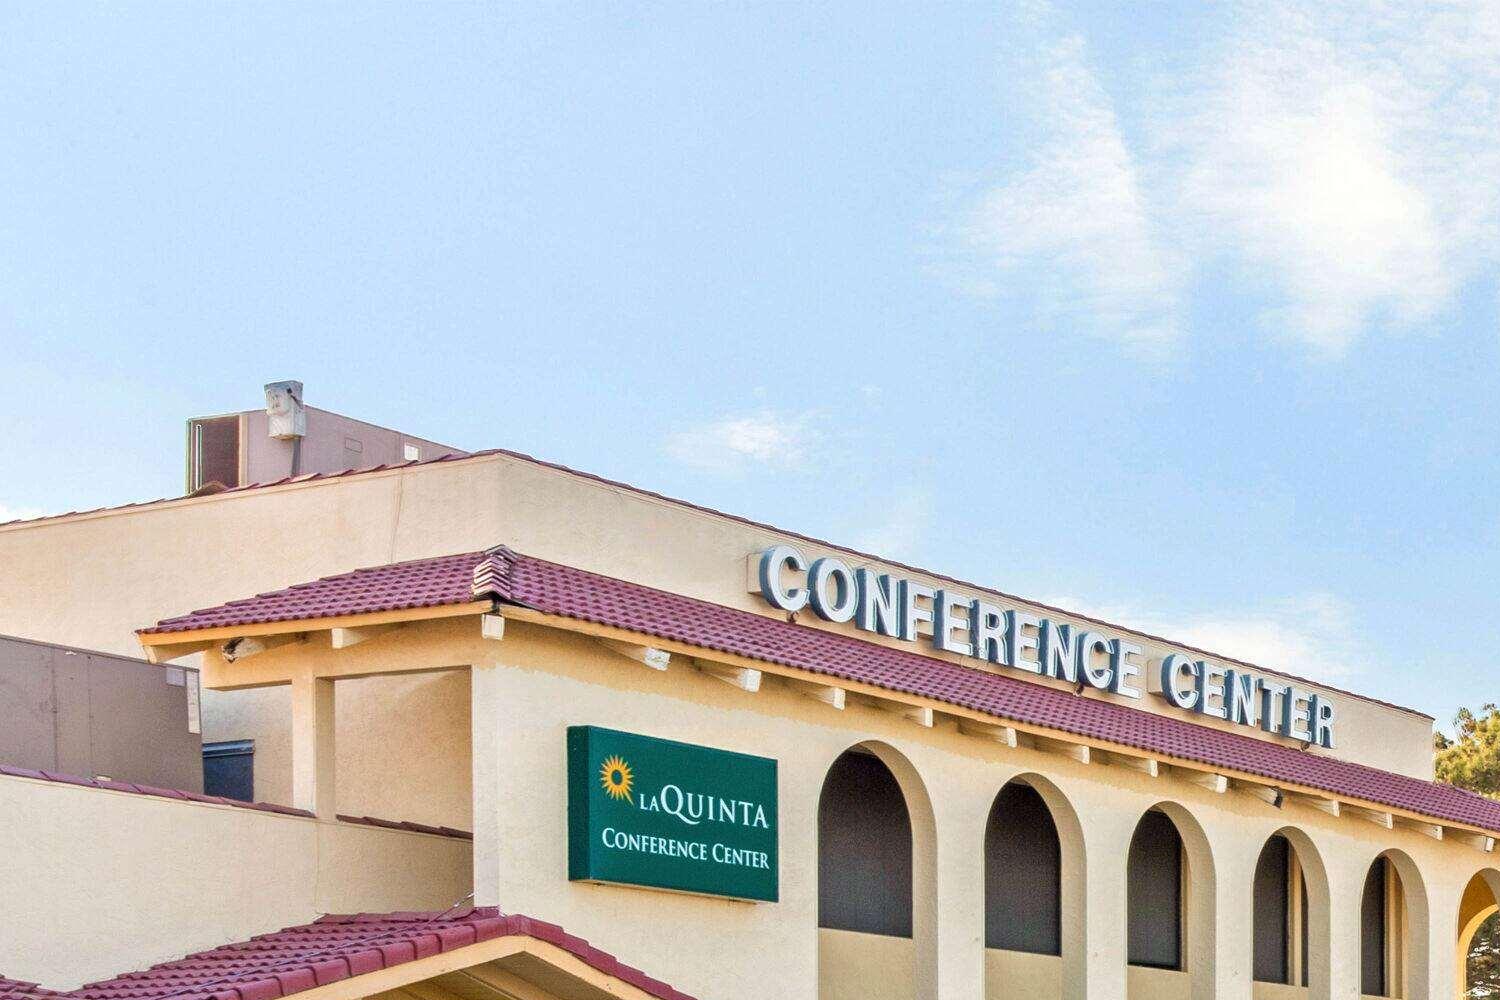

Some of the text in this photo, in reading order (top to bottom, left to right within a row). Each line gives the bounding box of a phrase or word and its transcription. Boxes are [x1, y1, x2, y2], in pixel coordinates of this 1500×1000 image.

[759, 544, 1337, 750] CONFERENCE CENTER
[602, 828, 770, 870] CONFERENCE CENTER
